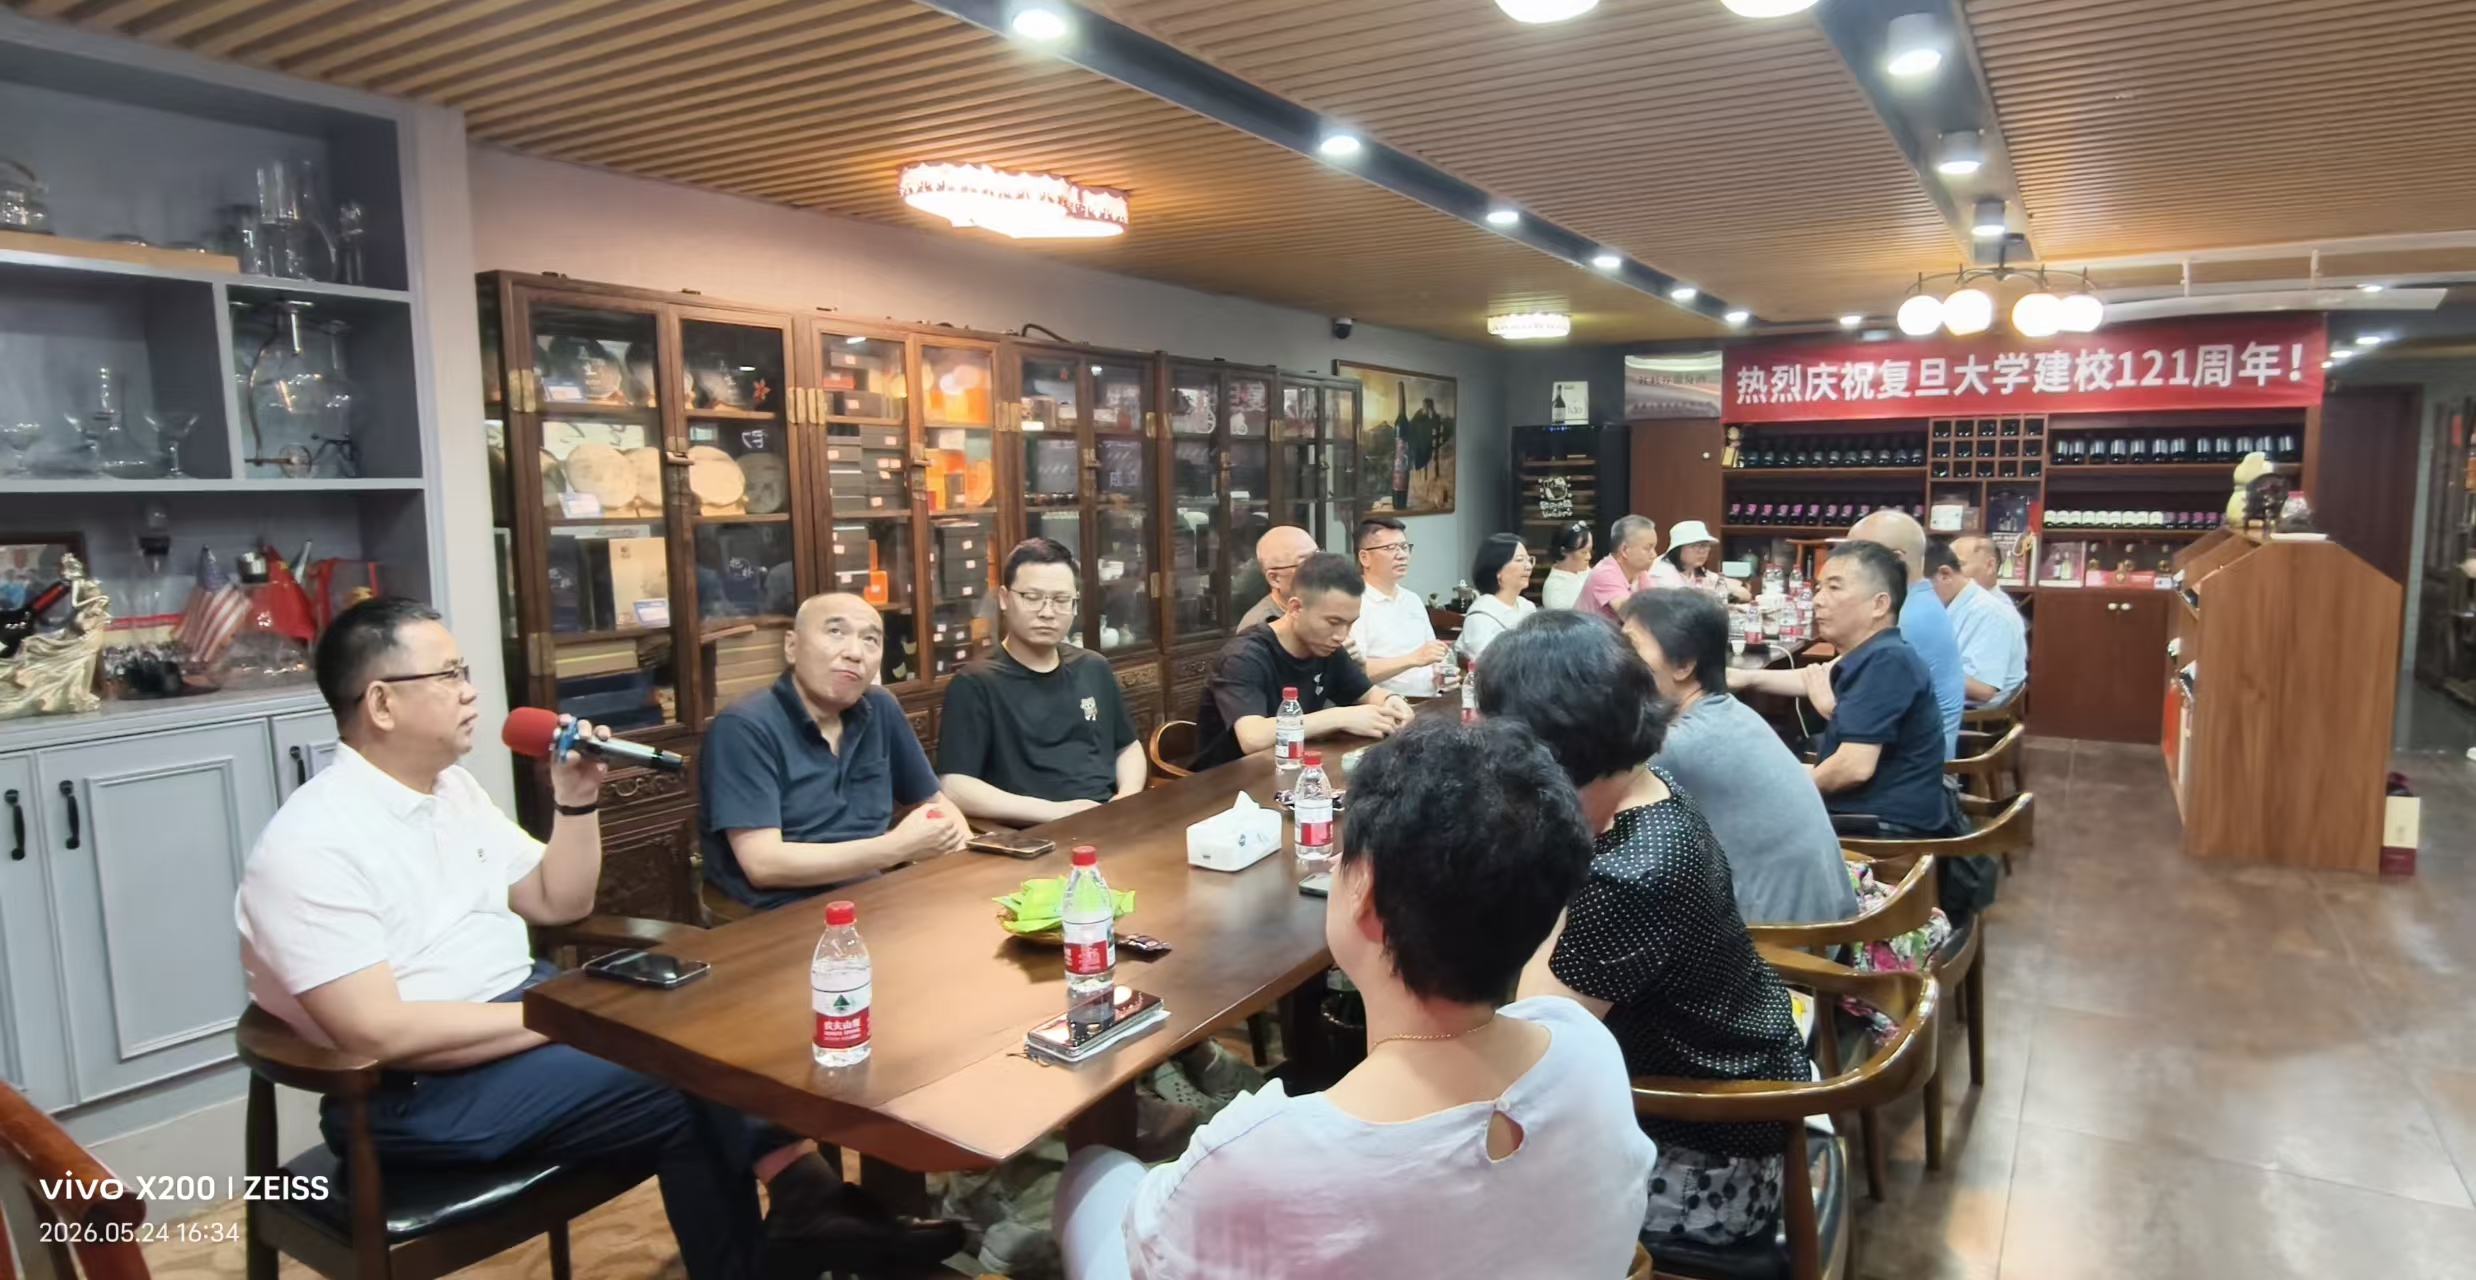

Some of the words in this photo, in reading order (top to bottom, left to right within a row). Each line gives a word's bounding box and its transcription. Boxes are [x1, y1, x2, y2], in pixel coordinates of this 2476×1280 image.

[1736, 341, 2303, 405] 热烈庆祝复旦大学建校121周年！
